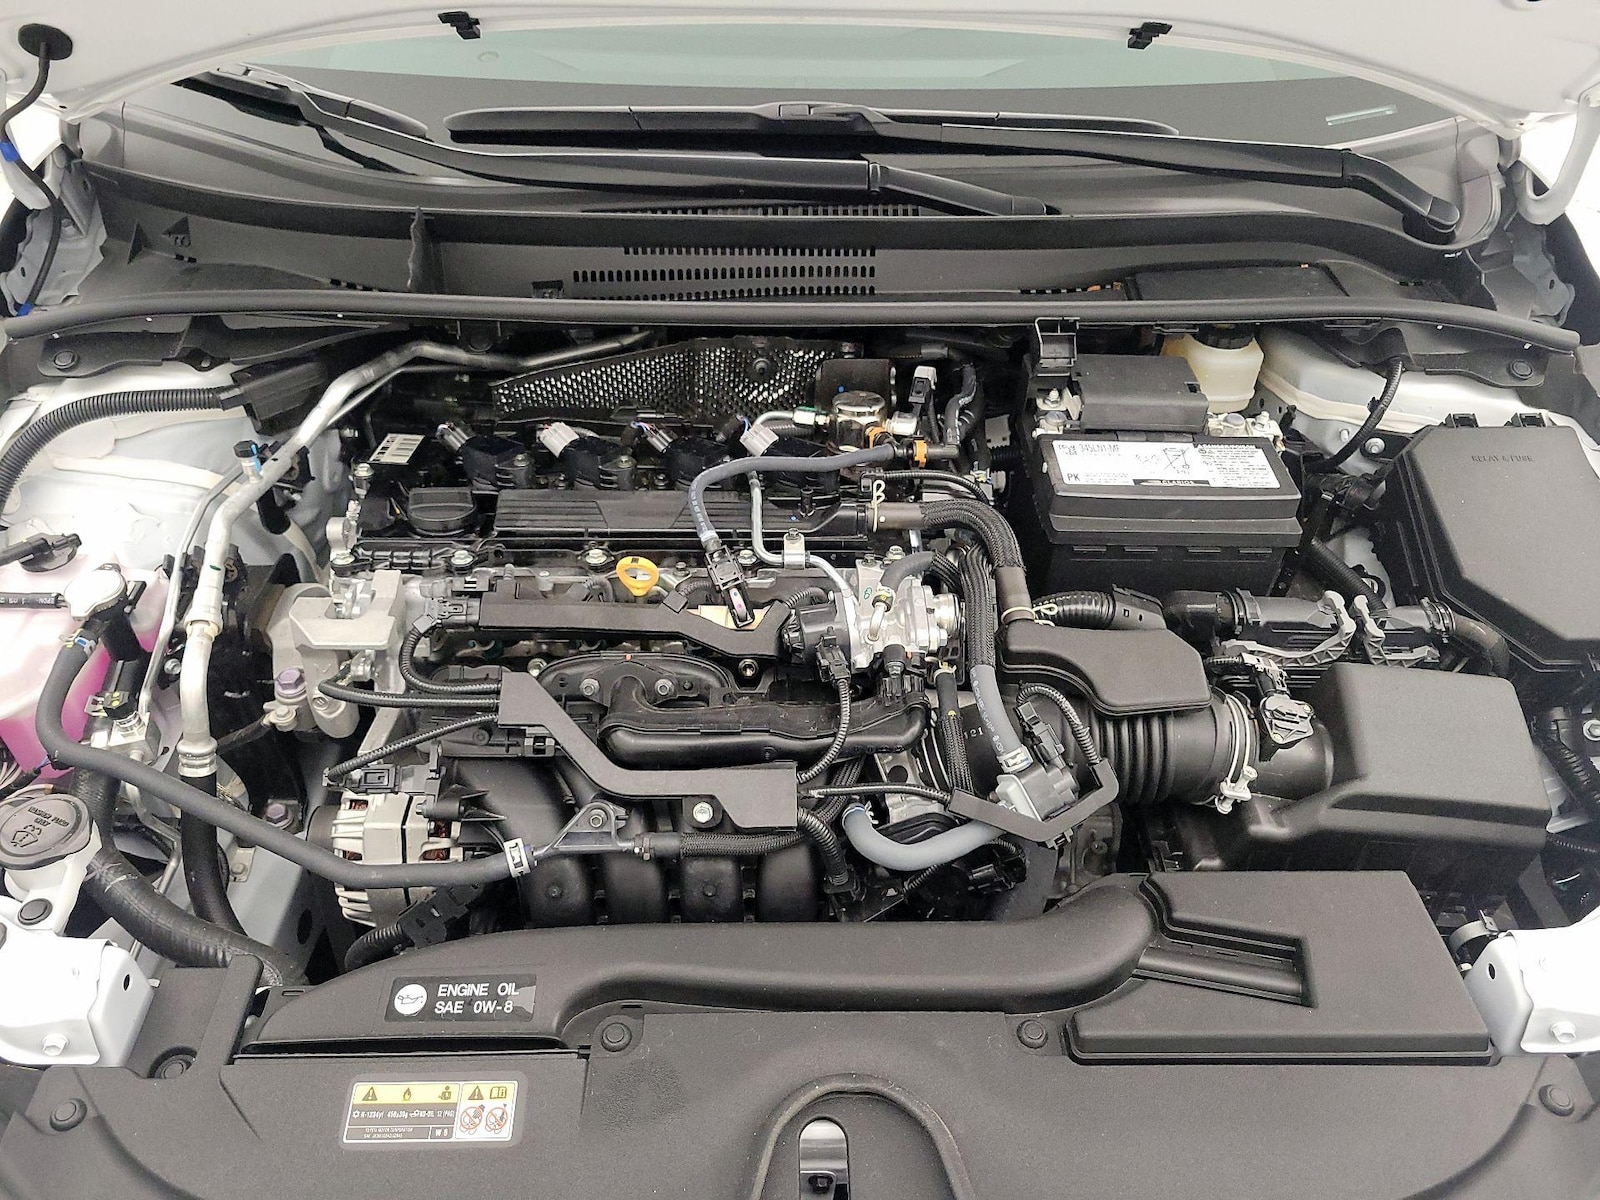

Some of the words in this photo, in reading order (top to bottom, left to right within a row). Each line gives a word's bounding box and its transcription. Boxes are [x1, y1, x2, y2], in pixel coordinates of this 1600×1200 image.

[1067, 473, 1081, 482] PK
[437, 983, 489, 997] ENGINE
[497, 982, 520, 996] OIL
[434, 1001, 464, 1014] SAE
[473, 1000, 514, 1014] 0W-8
